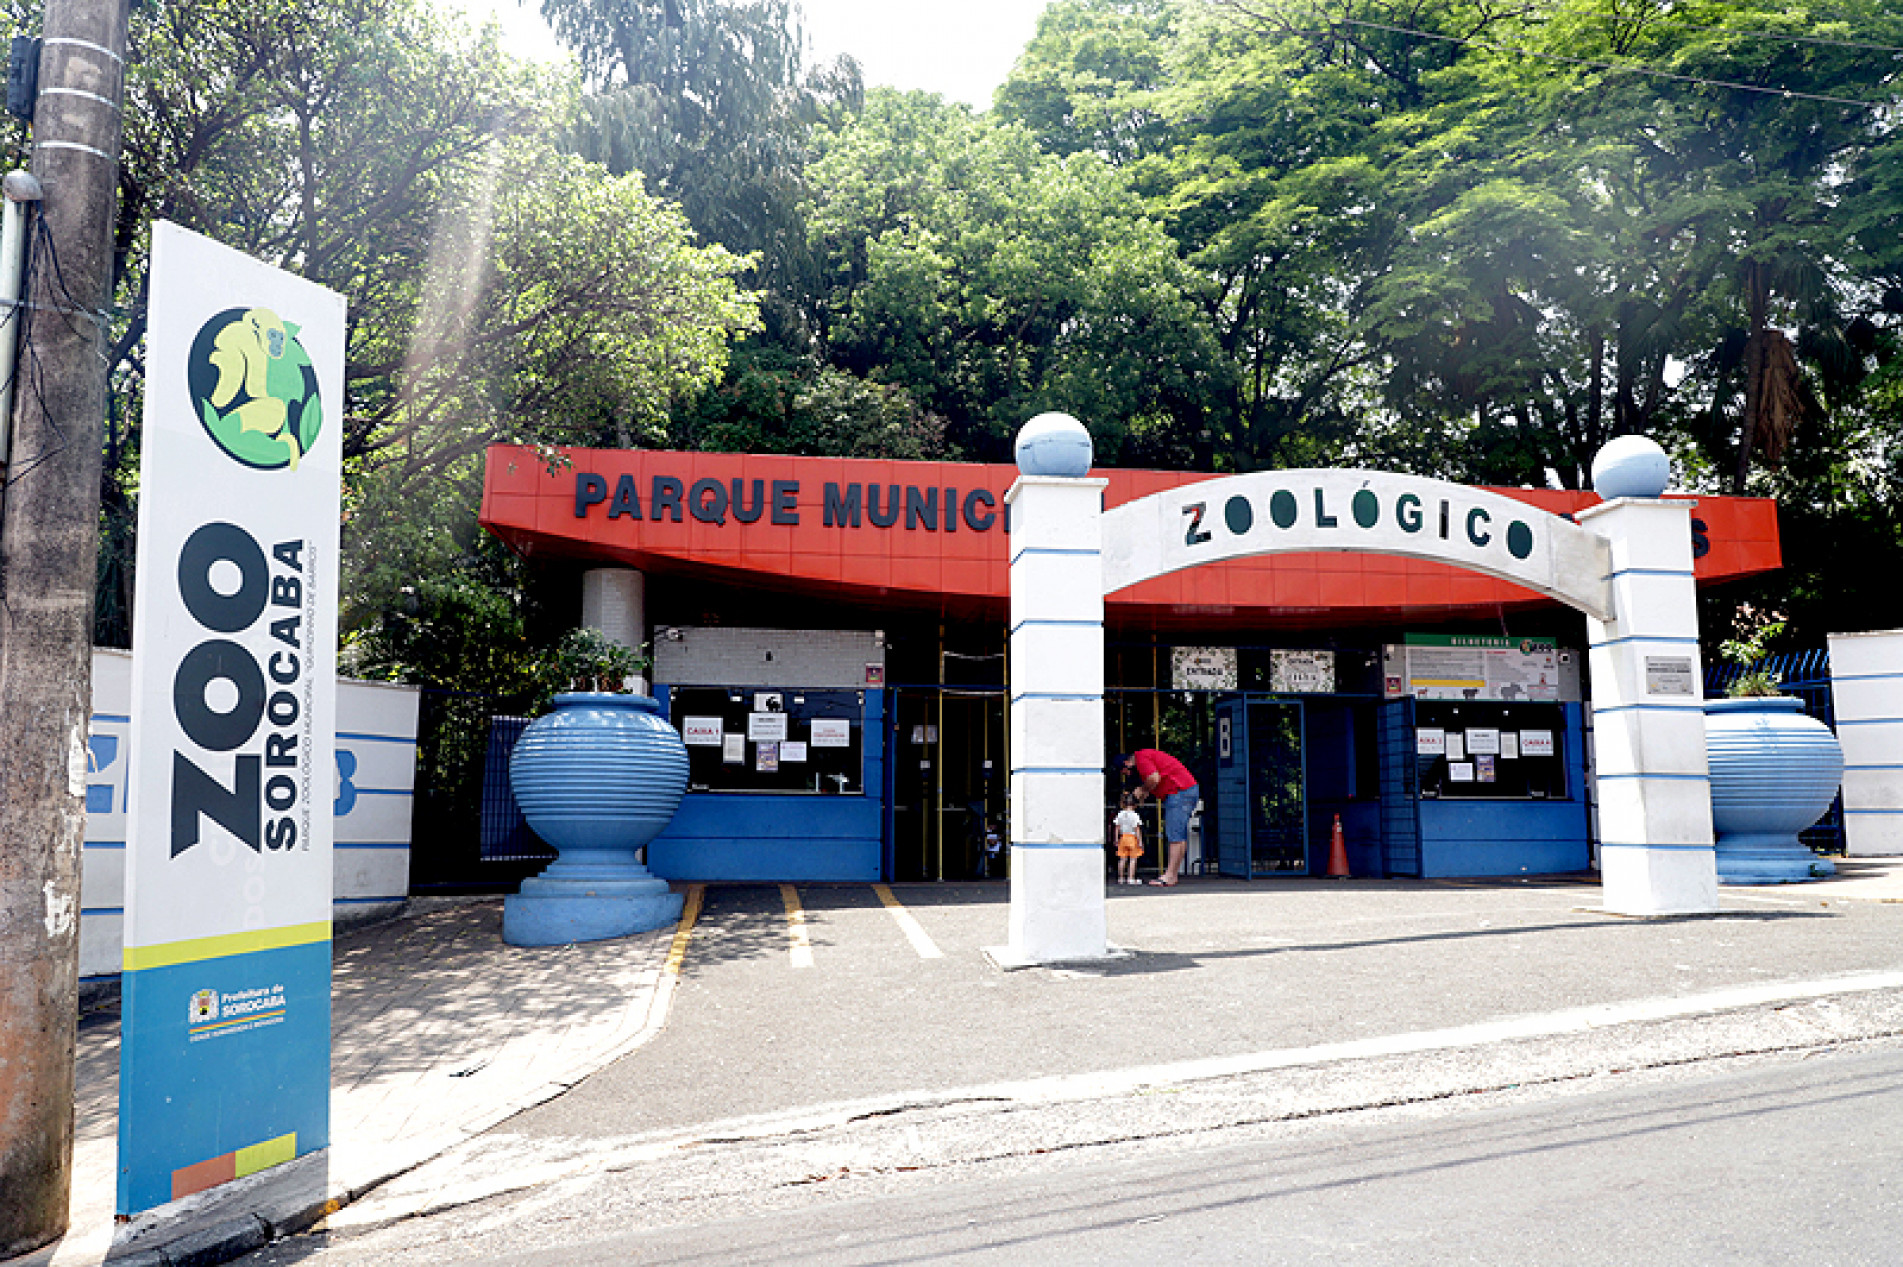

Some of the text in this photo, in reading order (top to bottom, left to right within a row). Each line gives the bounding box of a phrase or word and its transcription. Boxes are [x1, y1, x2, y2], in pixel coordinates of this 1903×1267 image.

[575, 472, 800, 526] PARQUE
[1181, 480, 1534, 560] ZOOLÓGICO
[169, 520, 270, 861] ZOO
[265, 538, 303, 852] SOROCABA
